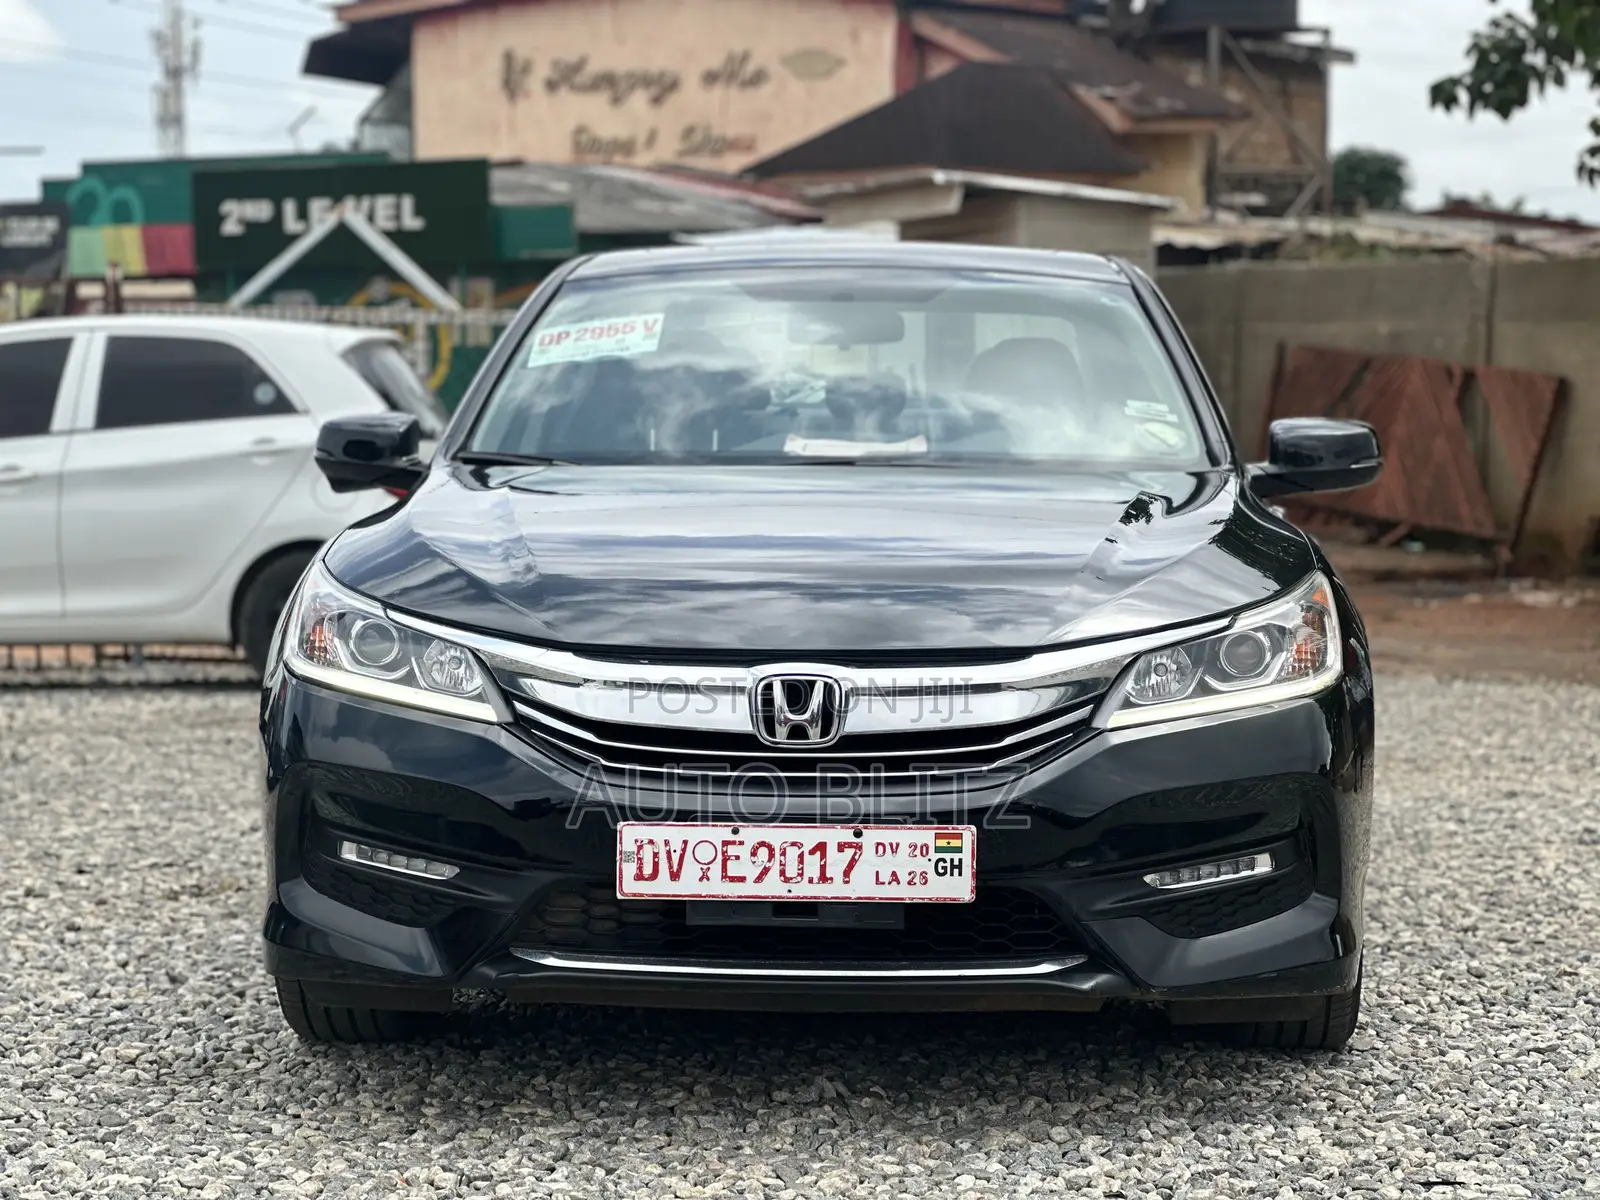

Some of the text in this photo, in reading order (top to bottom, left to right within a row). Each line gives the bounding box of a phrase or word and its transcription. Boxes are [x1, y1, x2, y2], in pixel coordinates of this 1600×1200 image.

[281, 193, 426, 235] LEVEL
[874, 842, 930, 858] DV 20
[721, 840, 863, 884] E9017
[934, 857, 963, 877] GH
[874, 870, 929, 886] LA 26
